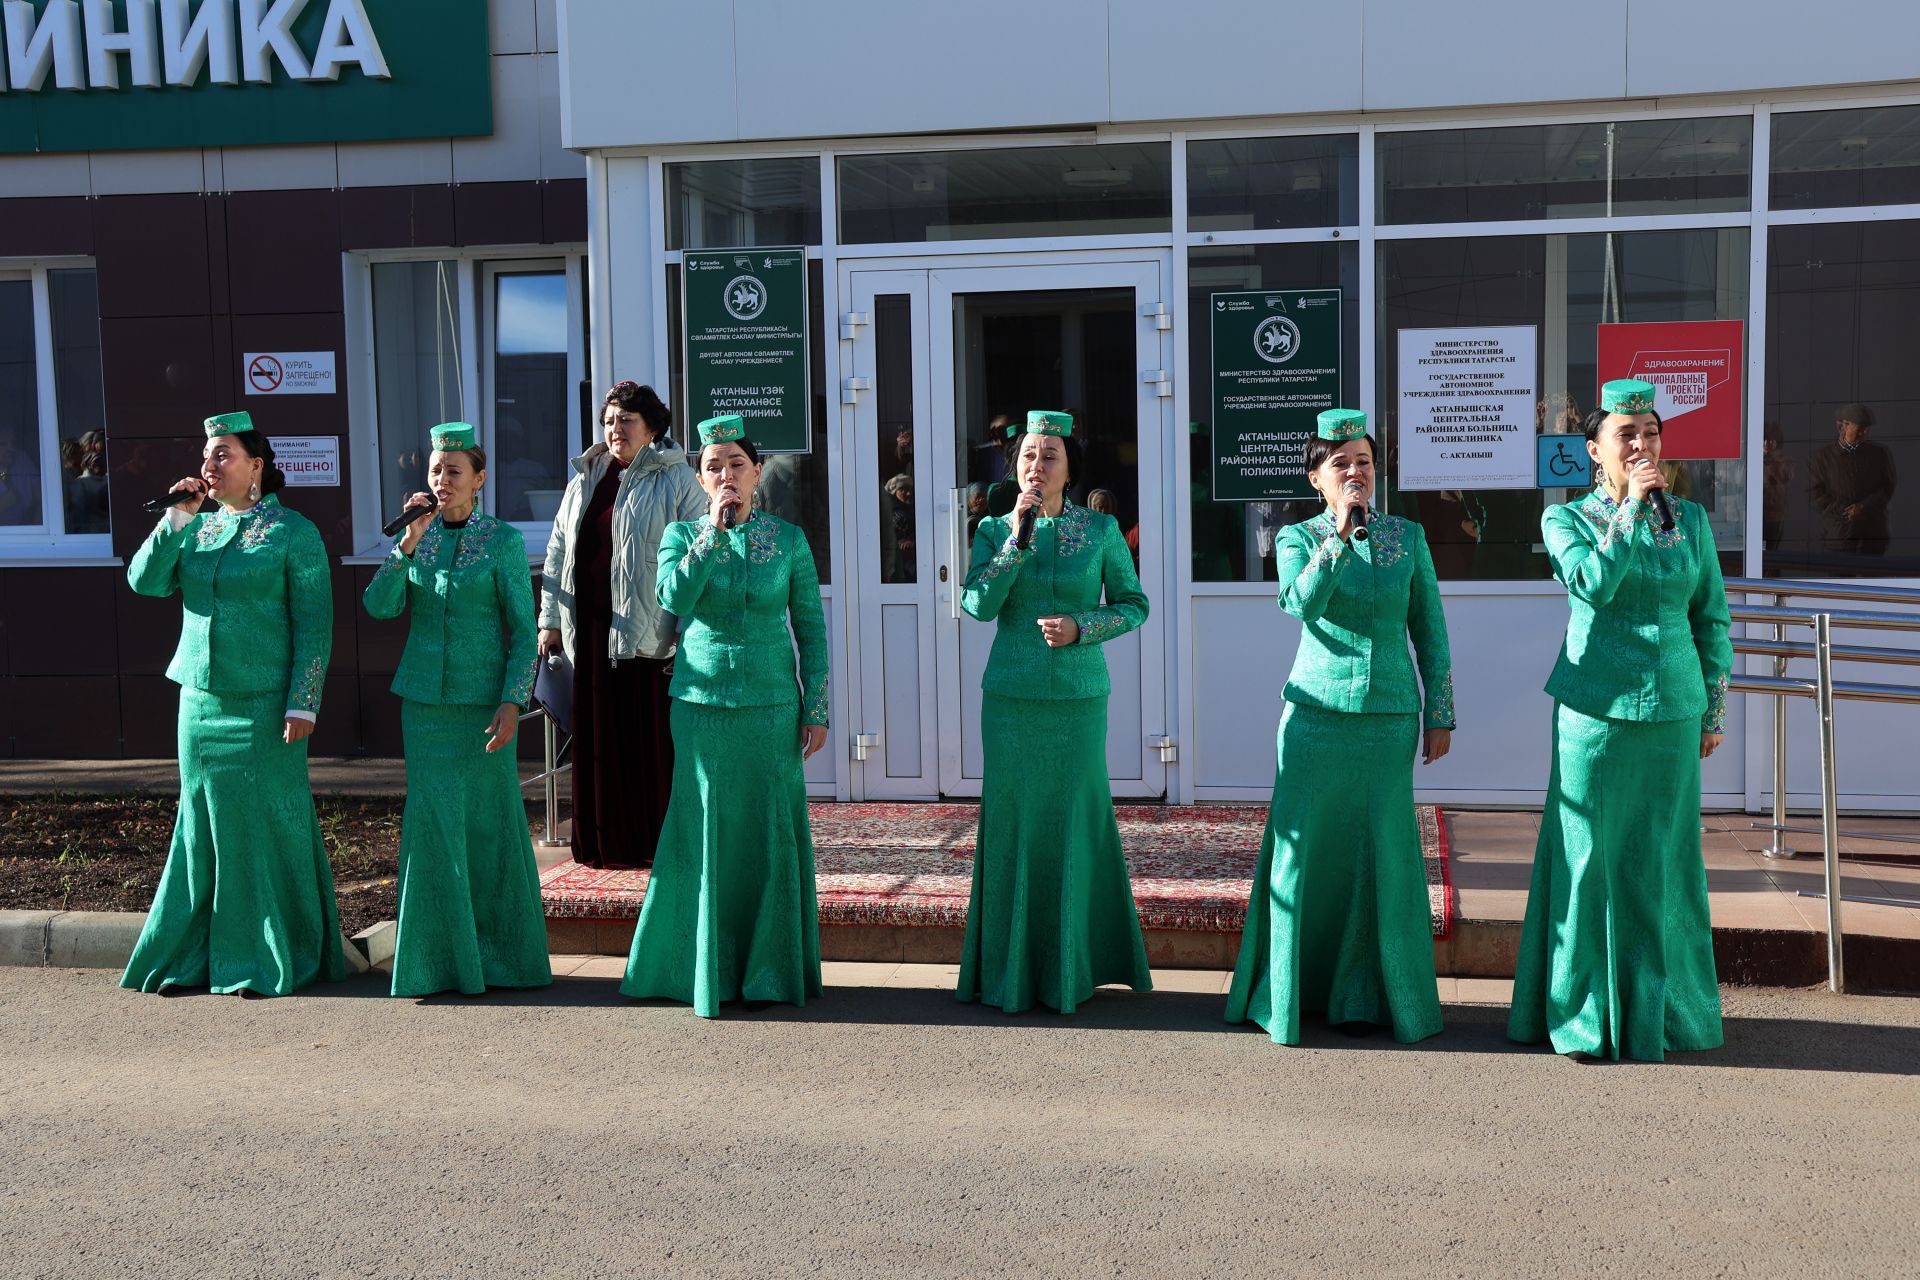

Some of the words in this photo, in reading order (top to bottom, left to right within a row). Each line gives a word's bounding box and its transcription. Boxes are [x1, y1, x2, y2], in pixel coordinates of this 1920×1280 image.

[0, 0, 391, 92] ИНИКА
[1435, 340, 1499, 348] МИНИСТЕРСТВО
[1430, 348, 1504, 357] ЗДРАВООХРАНЕНИЯ
[1471, 356, 1516, 364] ТАТАРСТАН
[1644, 359, 1725, 369] ЗДРАВООХРАНЕНИЕ
[286, 361, 313, 369] КУРИТЬ
[286, 371, 332, 380] ЗАПРЕЩЕНО!
[1219, 369, 1271, 377] МИНИСТЕРСТВО
[1272, 368, 1336, 376] ЗДРАВООХРАНЕНИЯ
[1428, 373, 1505, 381] ГОСУДАРСТВЕННОЕ
[1636, 374, 1706, 385] НАЦИОНАЛЬНЫЕ
[1440, 381, 1494, 389] АВТОНОМНОЕ
[1665, 384, 1705, 395] ПРОЕКТЫ
[710, 387, 759, 396] АКТАНЫШ
[760, 386, 785, 395] ҮЗӘК
[1403, 390, 1456, 398] УЧРЕЖДЕНИЕ
[1457, 388, 1531, 397] ЗДРАВООХРАНЕНИЯ
[713, 397, 782, 407] ХАСТАХАНӘСЕ
[1672, 395, 1705, 405] РОССИИ
[1224, 402, 1267, 410] УЧРЕЖДЕНИЕ
[1268, 401, 1332, 409] ЗДРАВООХРАНЕНИЯ
[1430, 404, 1504, 413] АКТАНЫШСКАЯ
[1433, 414, 1501, 424] ЦЕНТРАЛЬНАЯ
[1415, 424, 1465, 433] РАЙОННАЯ
[1467, 424, 1519, 433] БОЛЬНИЦА
[1431, 434, 1503, 443] ПОЛИКЛИНИКА
[1240, 443, 1307, 454] ЦЕНТРАЛЬНА
[1220, 454, 1276, 465] РАЙОННАЯ
[1278, 455, 1305, 464] БОЛЬ
[1449, 451, 1493, 459] АКТАНЫШ
[276, 461, 334, 473] РЕЩЕНО!
[1240, 467, 1307, 476] ПОЛИКЛИНИ
